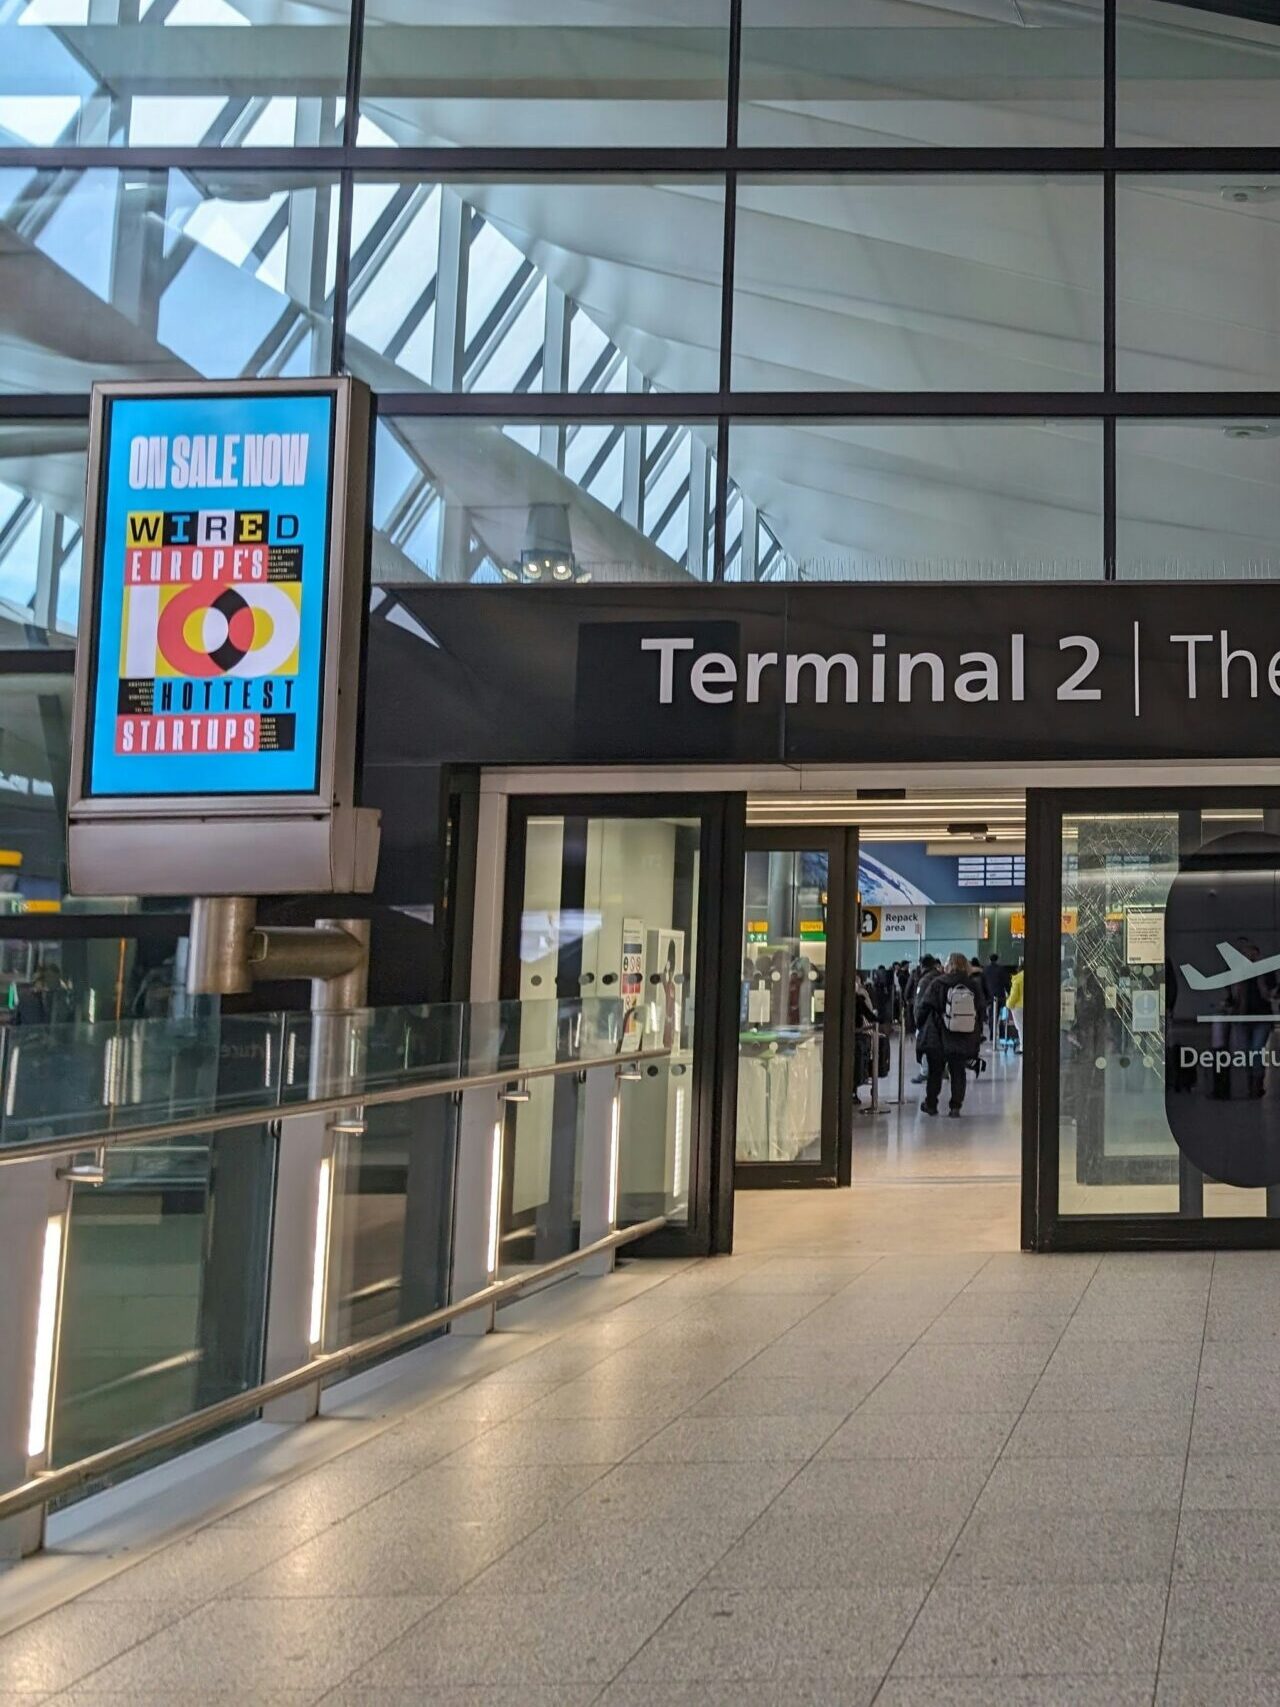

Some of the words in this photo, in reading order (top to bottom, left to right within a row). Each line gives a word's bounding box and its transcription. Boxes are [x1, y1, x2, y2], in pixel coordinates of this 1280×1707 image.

[128, 436, 168, 489] ON
[170, 434, 240, 488] SALE
[242, 433, 309, 487] NOW
[130, 513, 300, 543] WIRED
[131, 549, 263, 582] EUROPE'S
[641, 634, 1024, 703] Terminal
[1056, 635, 1102, 700] 2
[161, 680, 294, 711] HOTTEST
[122, 719, 254, 751] STARTUPS
[885, 913, 918, 923] Repack
[885, 924, 906, 932] area
